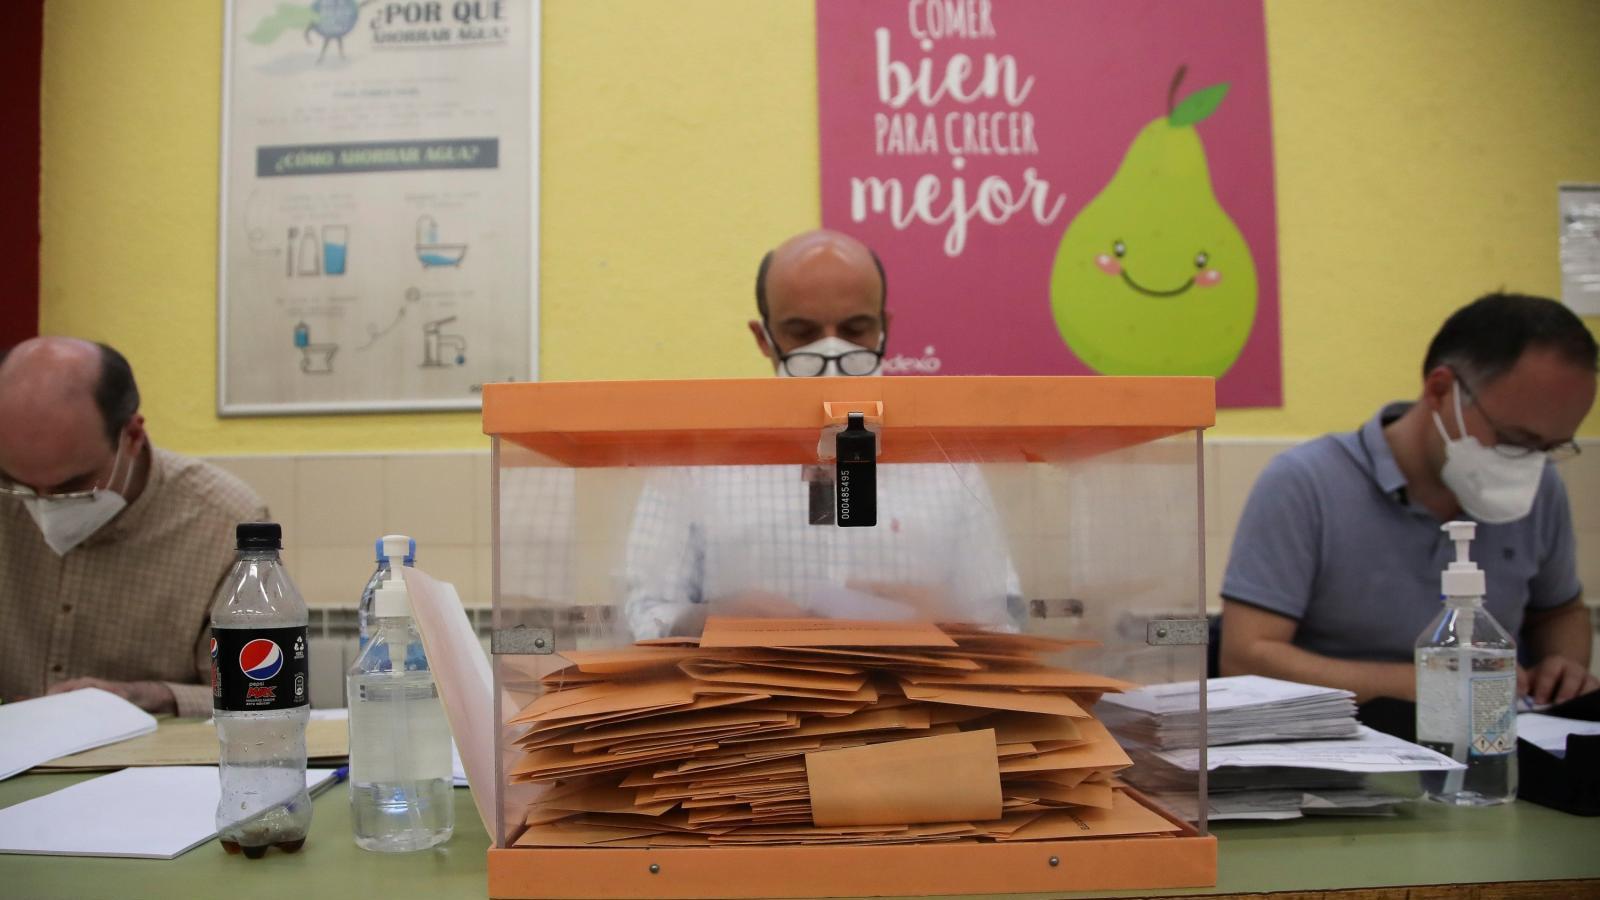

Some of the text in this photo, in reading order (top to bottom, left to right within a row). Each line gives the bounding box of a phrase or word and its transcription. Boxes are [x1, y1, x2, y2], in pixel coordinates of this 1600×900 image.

[908, 0, 997, 39] COMER
[875, 27, 1036, 108] bien
[874, 111, 1039, 155] PARA CRECER
[850, 156, 1067, 257] mejor
[841, 470, 850, 520] 000485495
